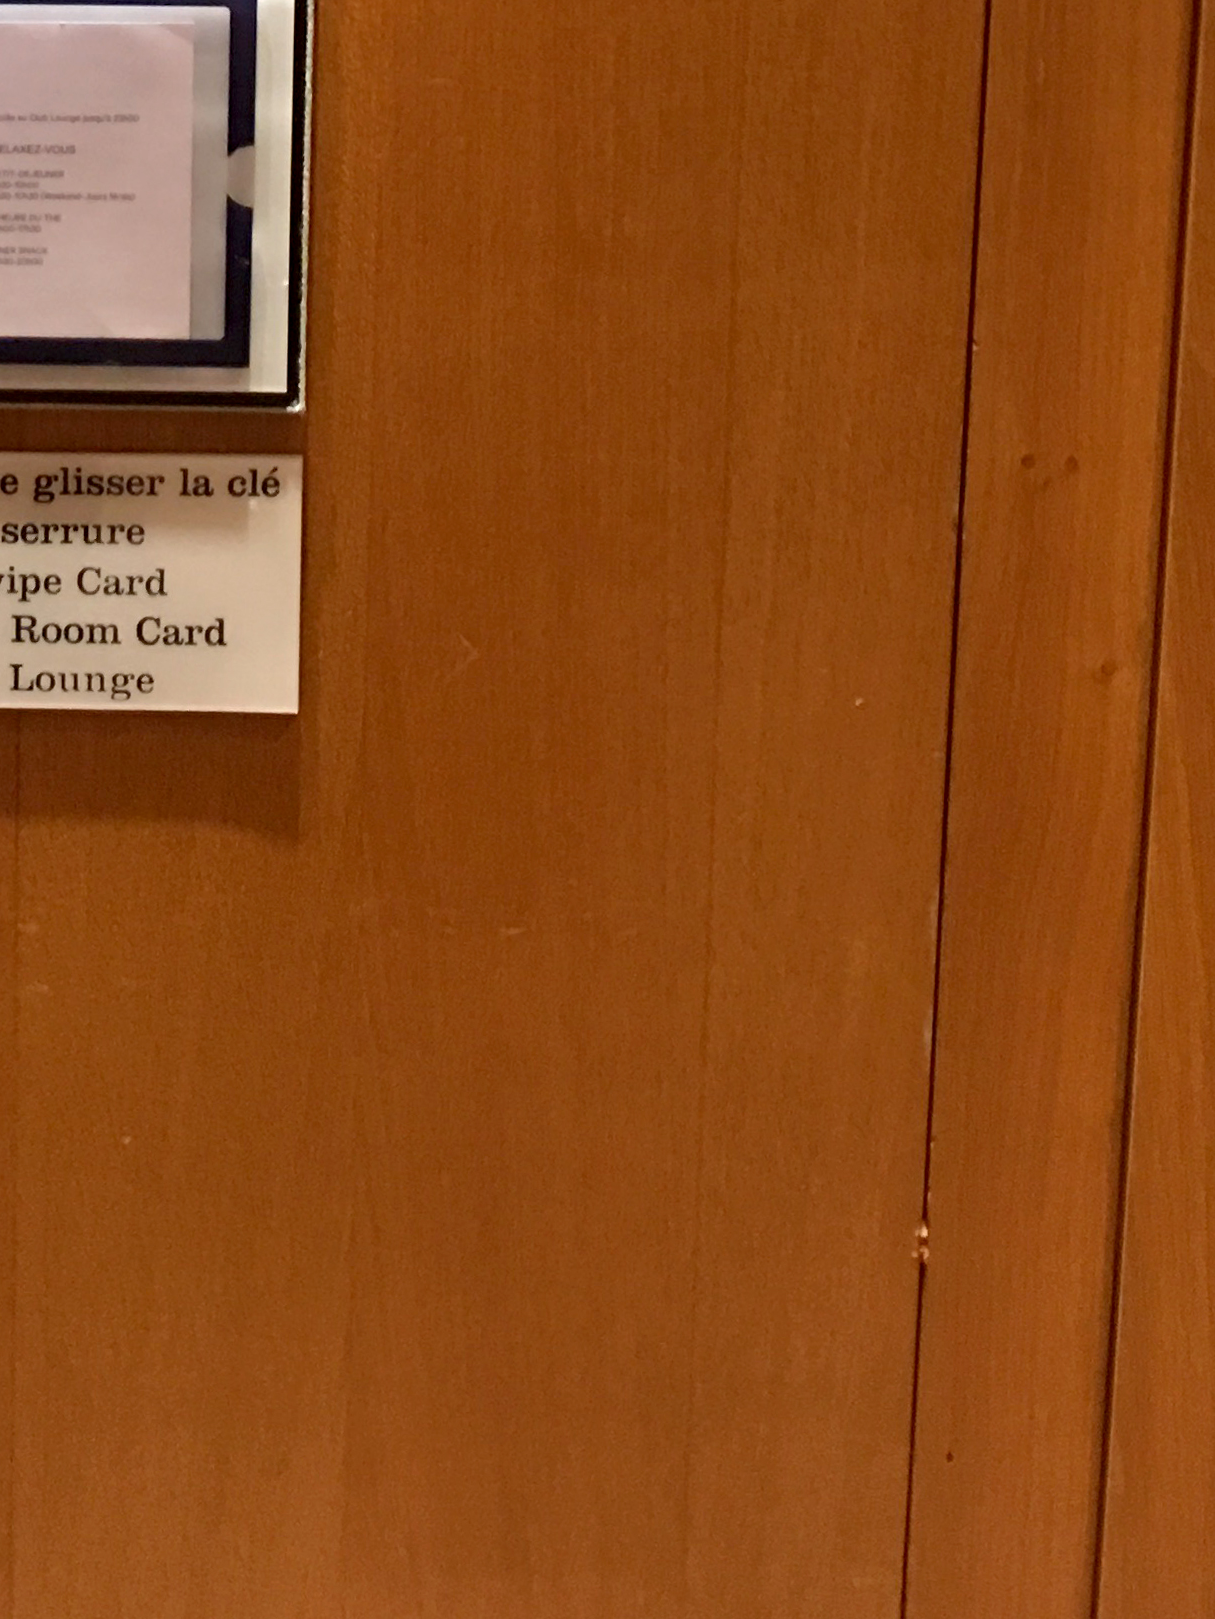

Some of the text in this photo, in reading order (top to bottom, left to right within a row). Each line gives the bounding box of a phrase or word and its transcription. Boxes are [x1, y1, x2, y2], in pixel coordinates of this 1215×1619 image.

[33, 466, 166, 505] glisser
[179, 468, 215, 498] la
[227, 463, 281, 499] clé
[0, 521, 146, 547] serrure
[76, 566, 168, 598] Card
[10, 614, 121, 646] Room
[135, 616, 228, 648] Card
[9, 663, 156, 698] Lounge
